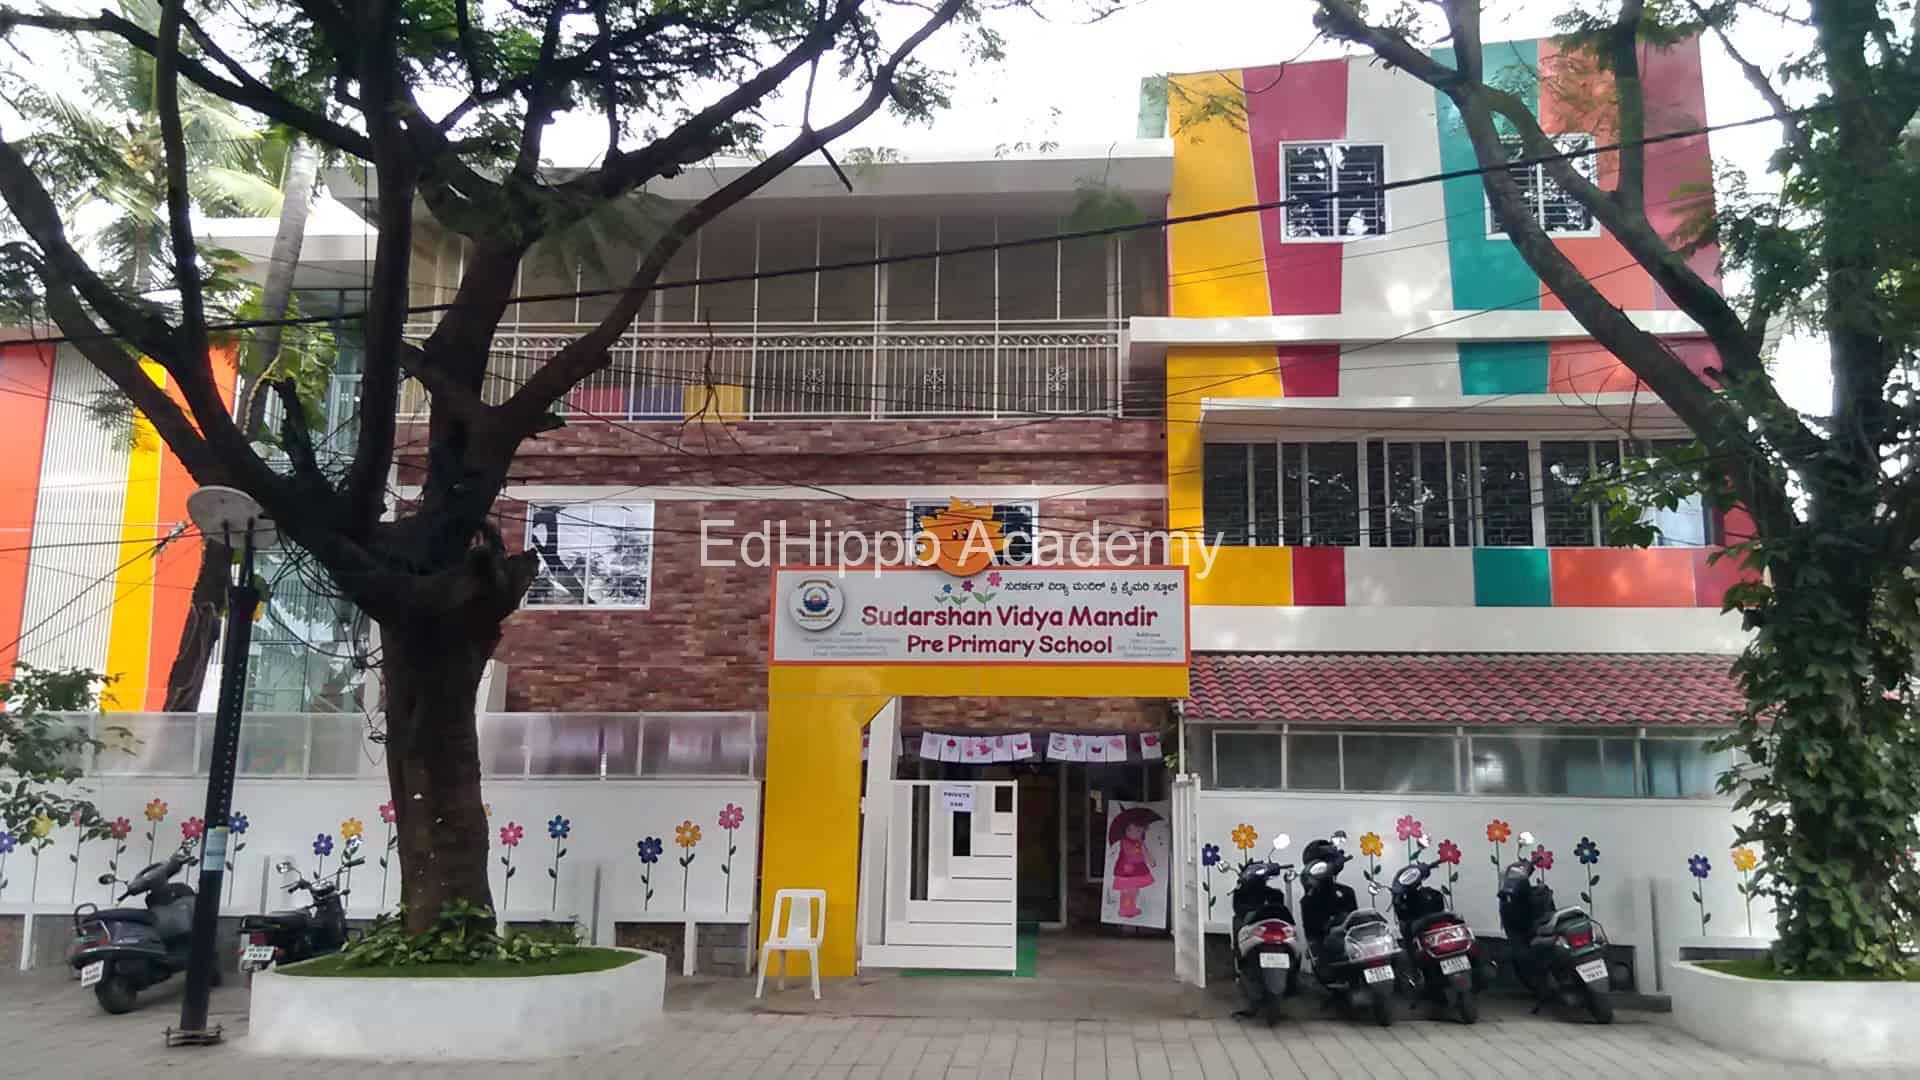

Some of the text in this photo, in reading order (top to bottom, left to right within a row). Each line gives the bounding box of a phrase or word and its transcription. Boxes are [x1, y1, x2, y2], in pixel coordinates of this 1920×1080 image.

[861, 605, 1159, 632] Sudarshan Vidya Mandir
[907, 634, 1113, 658] Pre Primary School
